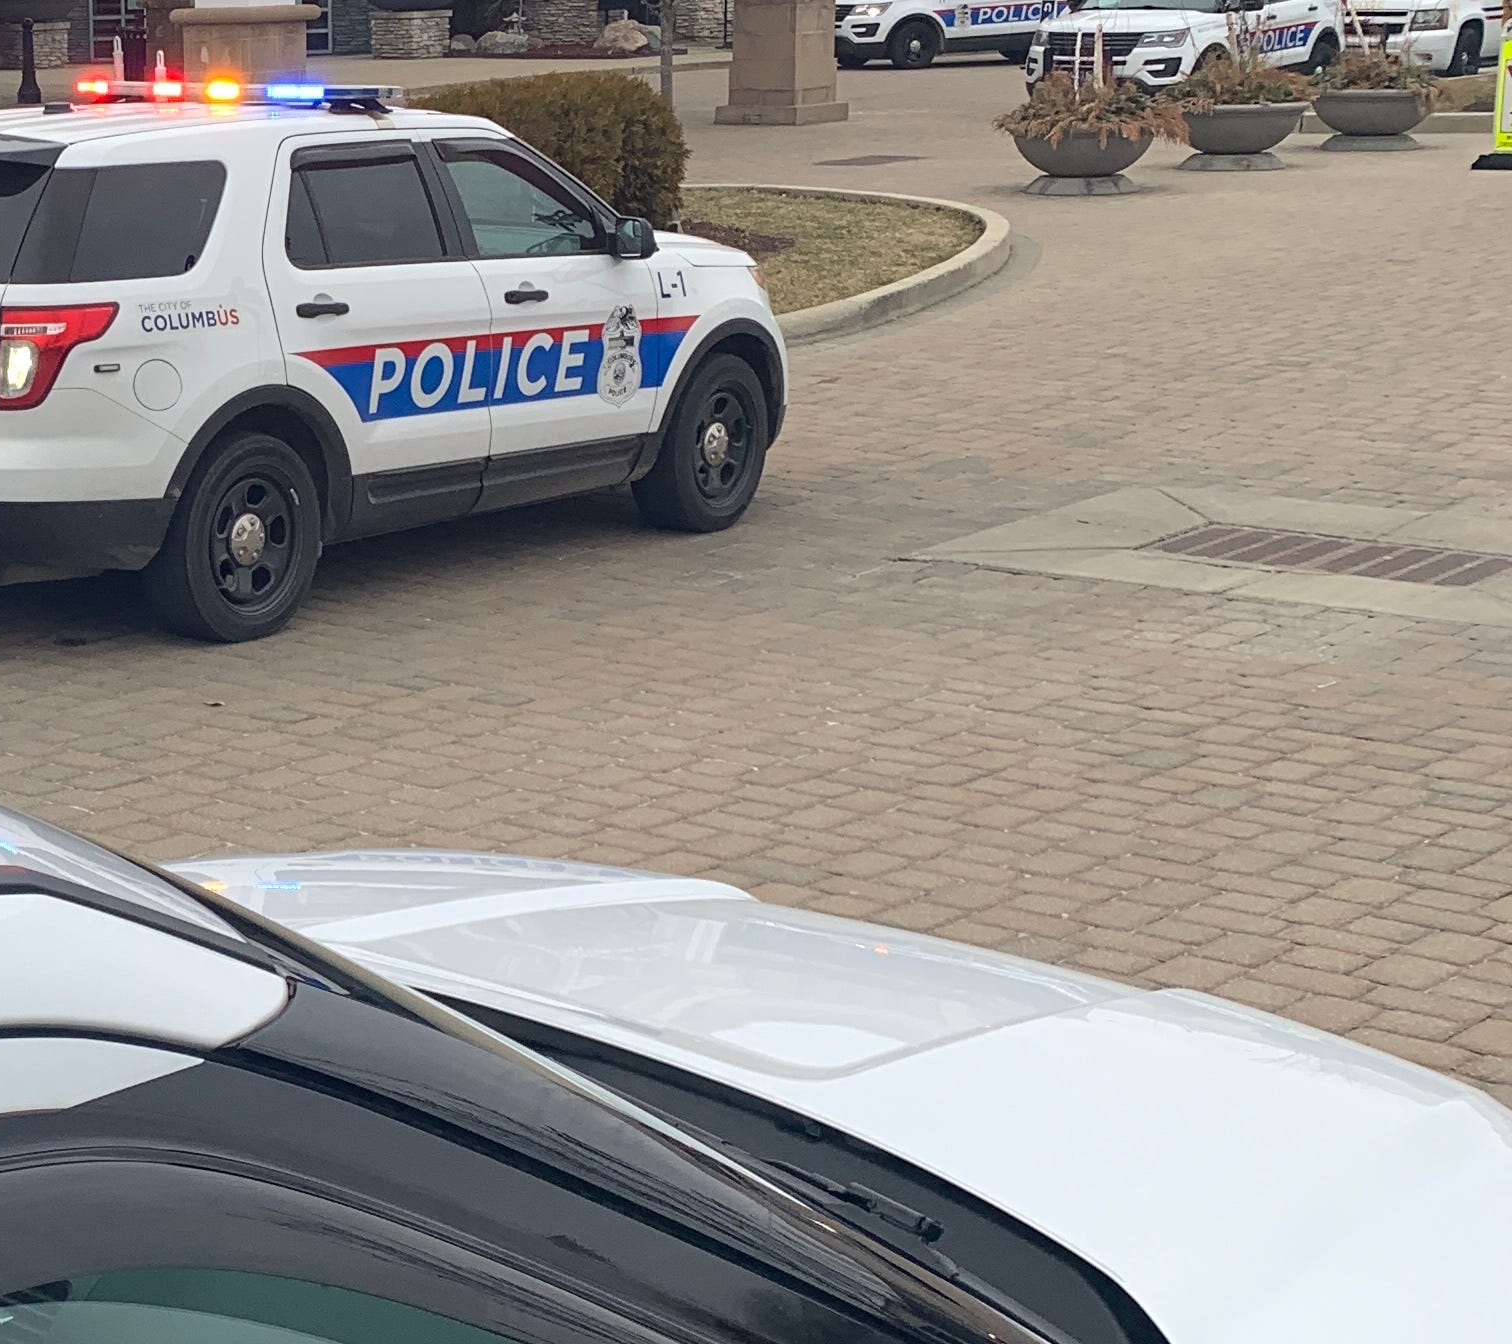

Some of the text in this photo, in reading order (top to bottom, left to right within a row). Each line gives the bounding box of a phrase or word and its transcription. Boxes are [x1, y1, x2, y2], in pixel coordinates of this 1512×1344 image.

[978, 3, 1042, 24] POLIC
[657, 270, 687, 298] L-1
[139, 300, 192, 313] THE CITY OF
[141, 309, 239, 332] COLUMBUS
[369, 329, 589, 415] POLICE
